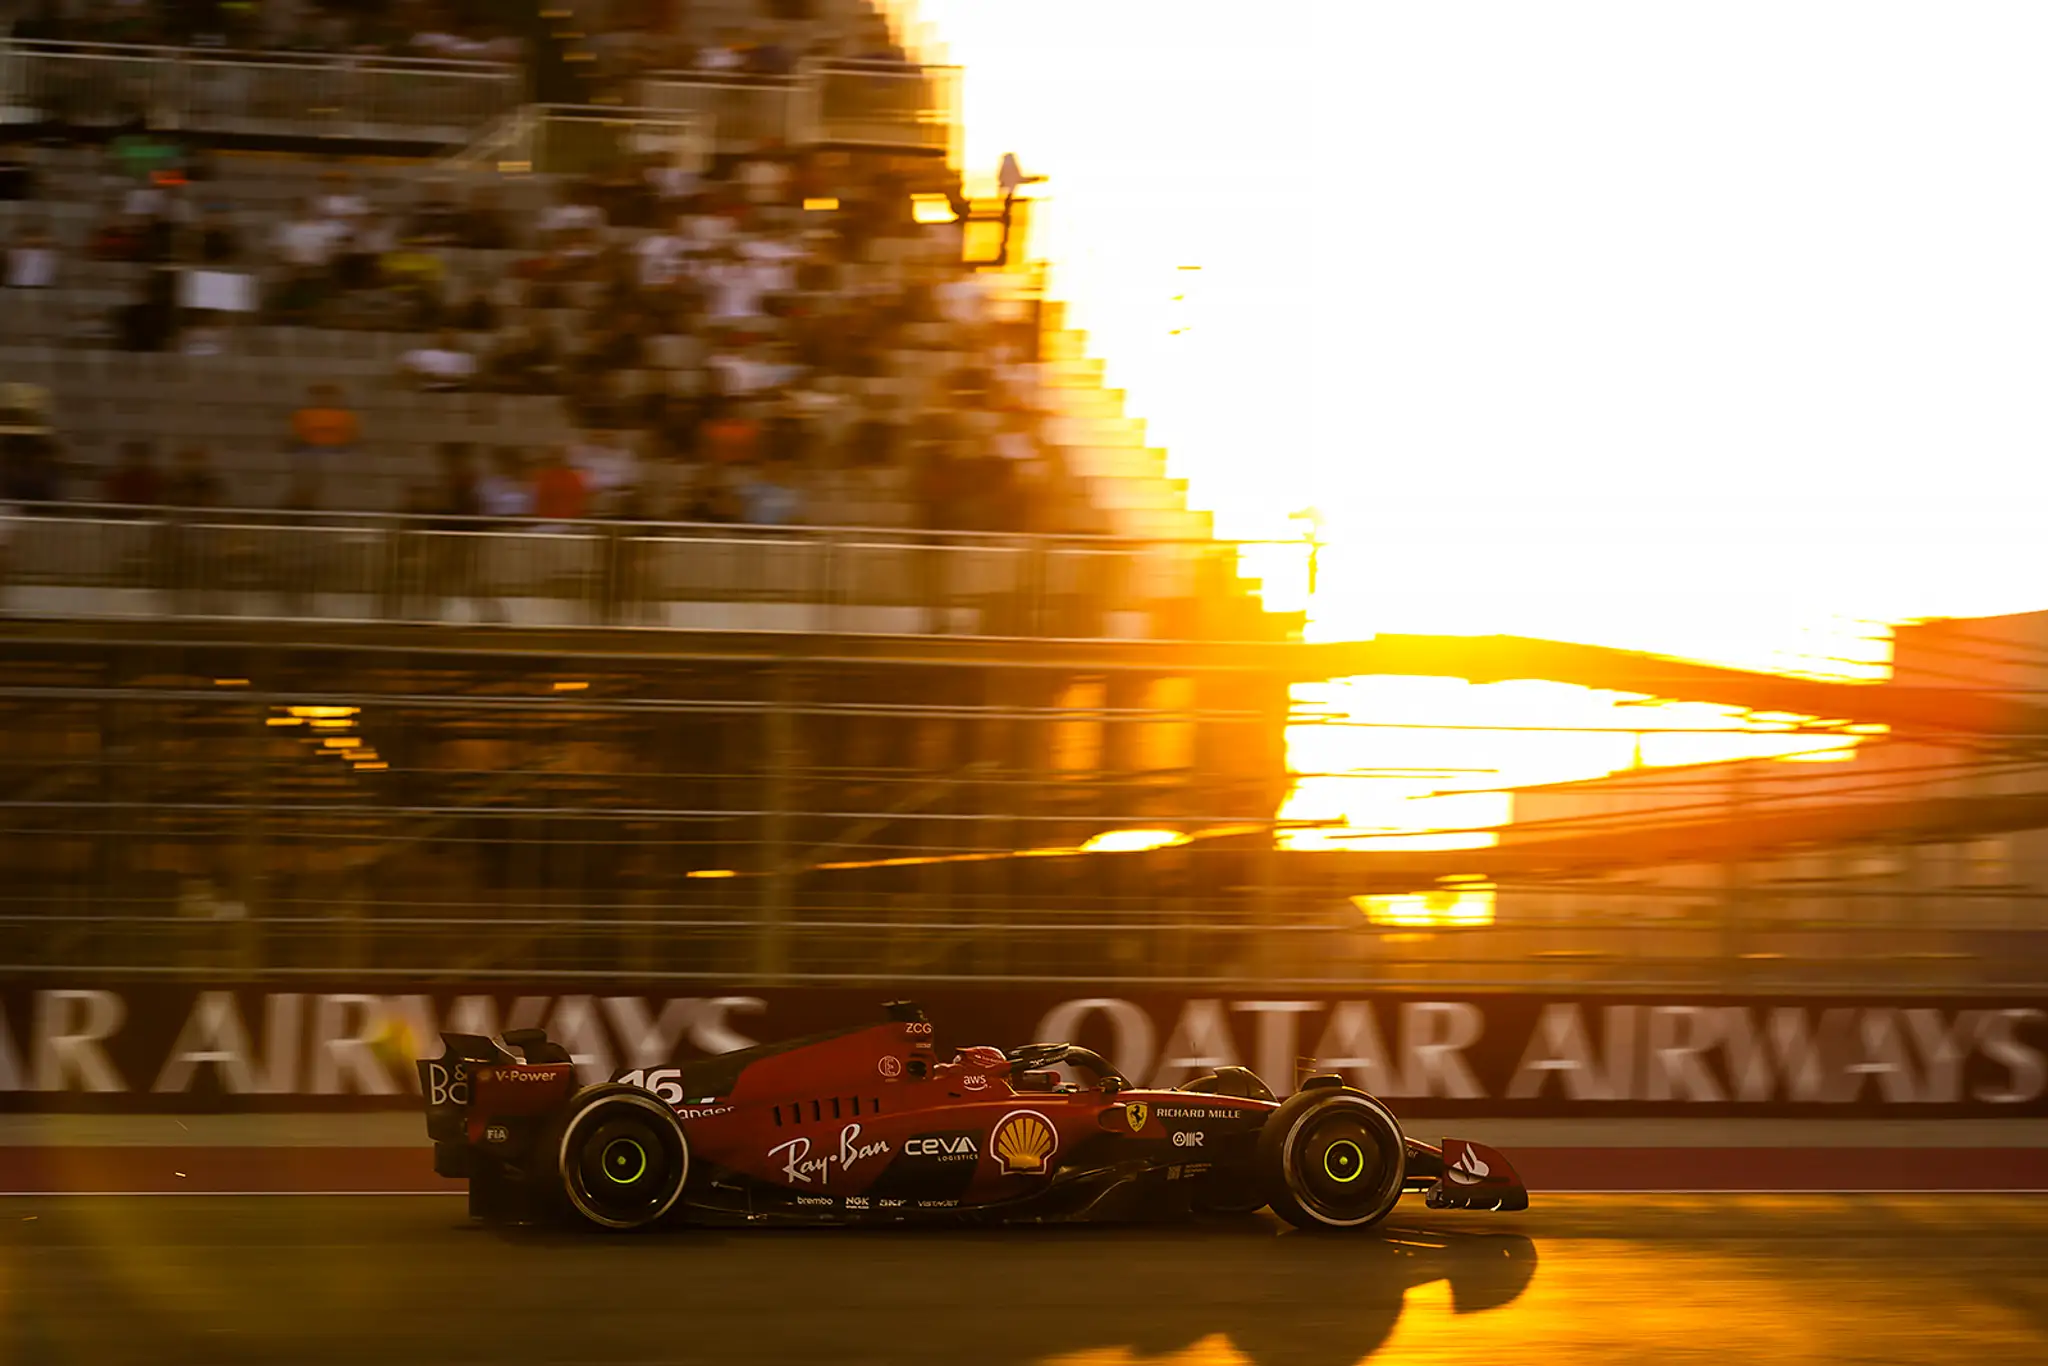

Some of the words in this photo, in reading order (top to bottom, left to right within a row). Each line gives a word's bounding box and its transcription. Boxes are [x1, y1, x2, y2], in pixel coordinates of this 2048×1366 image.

[905, 1022, 933, 1034] ZCG
[0, 989, 127, 1093] R
[1033, 998, 1484, 1099] QATAR
[1506, 1002, 2047, 1104] AIRWAYS
[496, 1070, 556, 1082] V-Power
[963, 1074, 987, 1084] aws
[617, 1068, 684, 1105] 16
[676, 1105, 735, 1120] ander
[1156, 1108, 1205, 1118] RICHARD
[1208, 1109, 1241, 1119] MILLE
[938, 1154, 979, 1162] LOGISTICS
[797, 1196, 834, 1205] brembo
[845, 1196, 870, 1205] NGK
